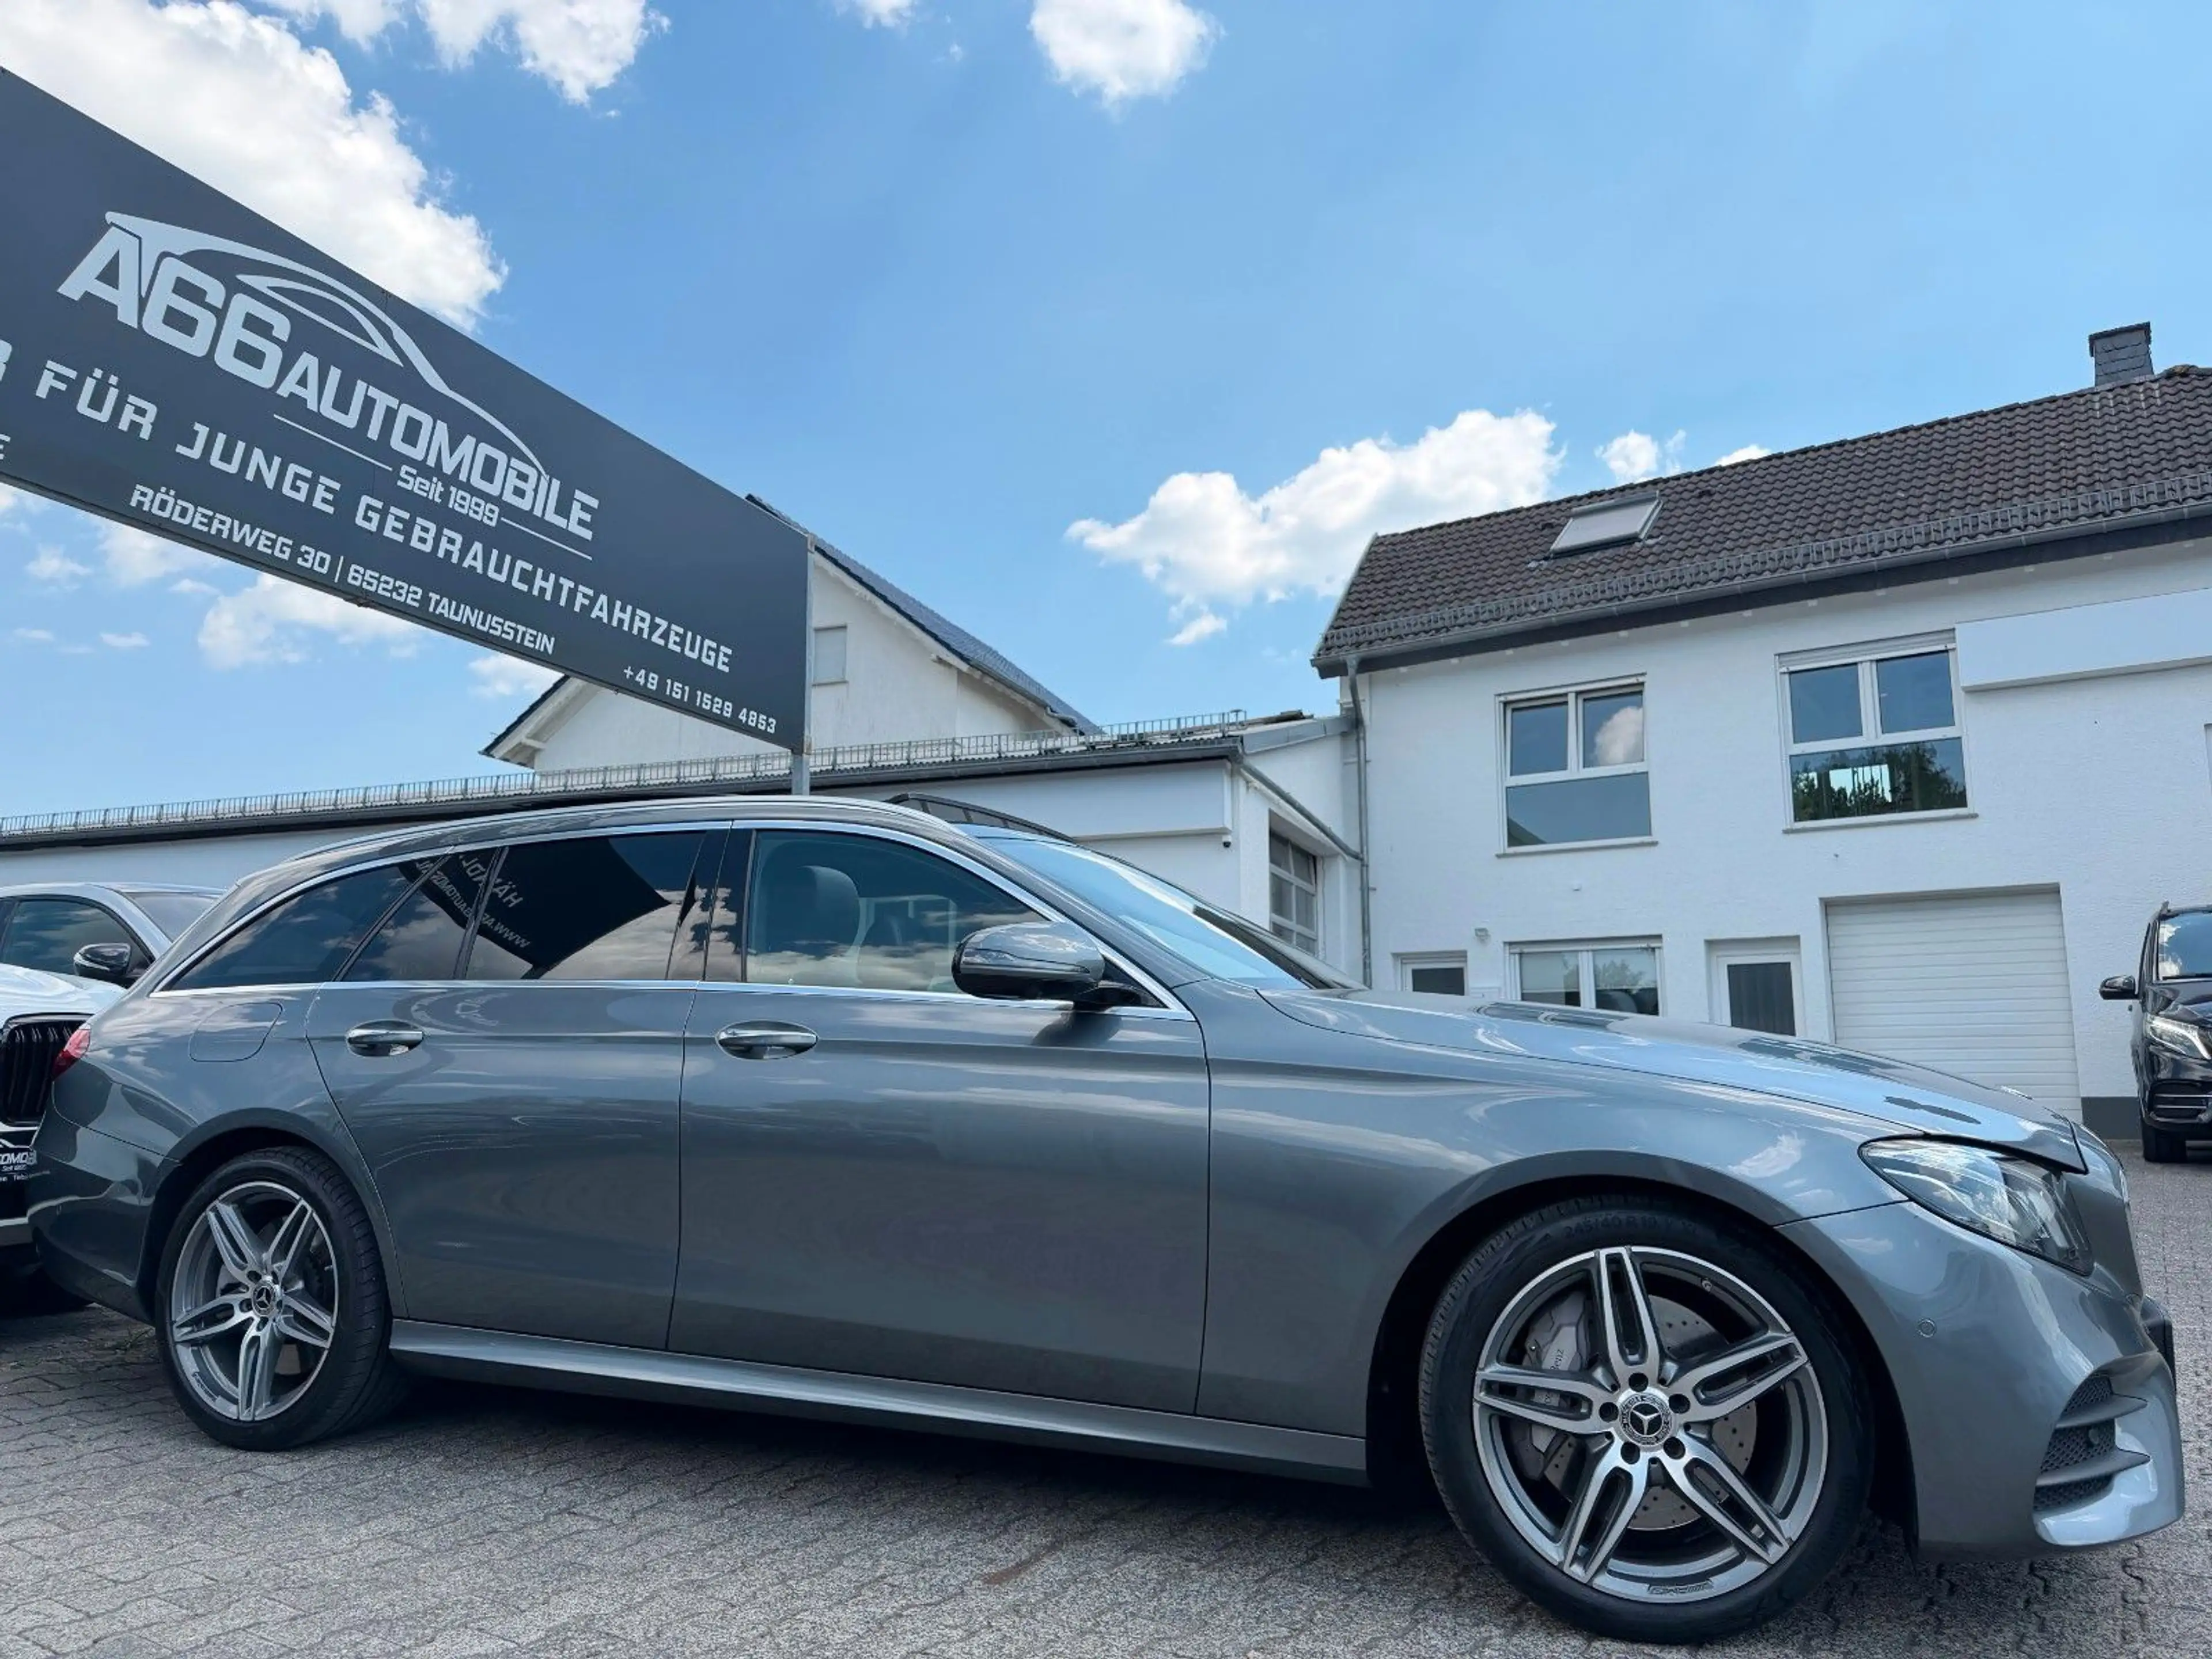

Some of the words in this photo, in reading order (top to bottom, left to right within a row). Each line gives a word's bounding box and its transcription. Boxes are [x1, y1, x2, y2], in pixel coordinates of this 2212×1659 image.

[36, 359, 157, 441] FÜR
[175, 422, 341, 514] JUNGE
[355, 495, 732, 673] GEBRAUCHTFAHRZEUGE
[397, 464, 445, 503] Seit
[448, 486, 500, 528] 1999
[130, 483, 293, 561] RÖDERWEG
[297, 544, 331, 575] 30
[347, 564, 423, 608] 65232
[429, 592, 555, 655] TAUNUSSTEIN
[624, 666, 659, 691] +49
[666, 679, 690, 702] 151
[696, 690, 733, 718] 1529
[738, 708, 777, 734] 4853
